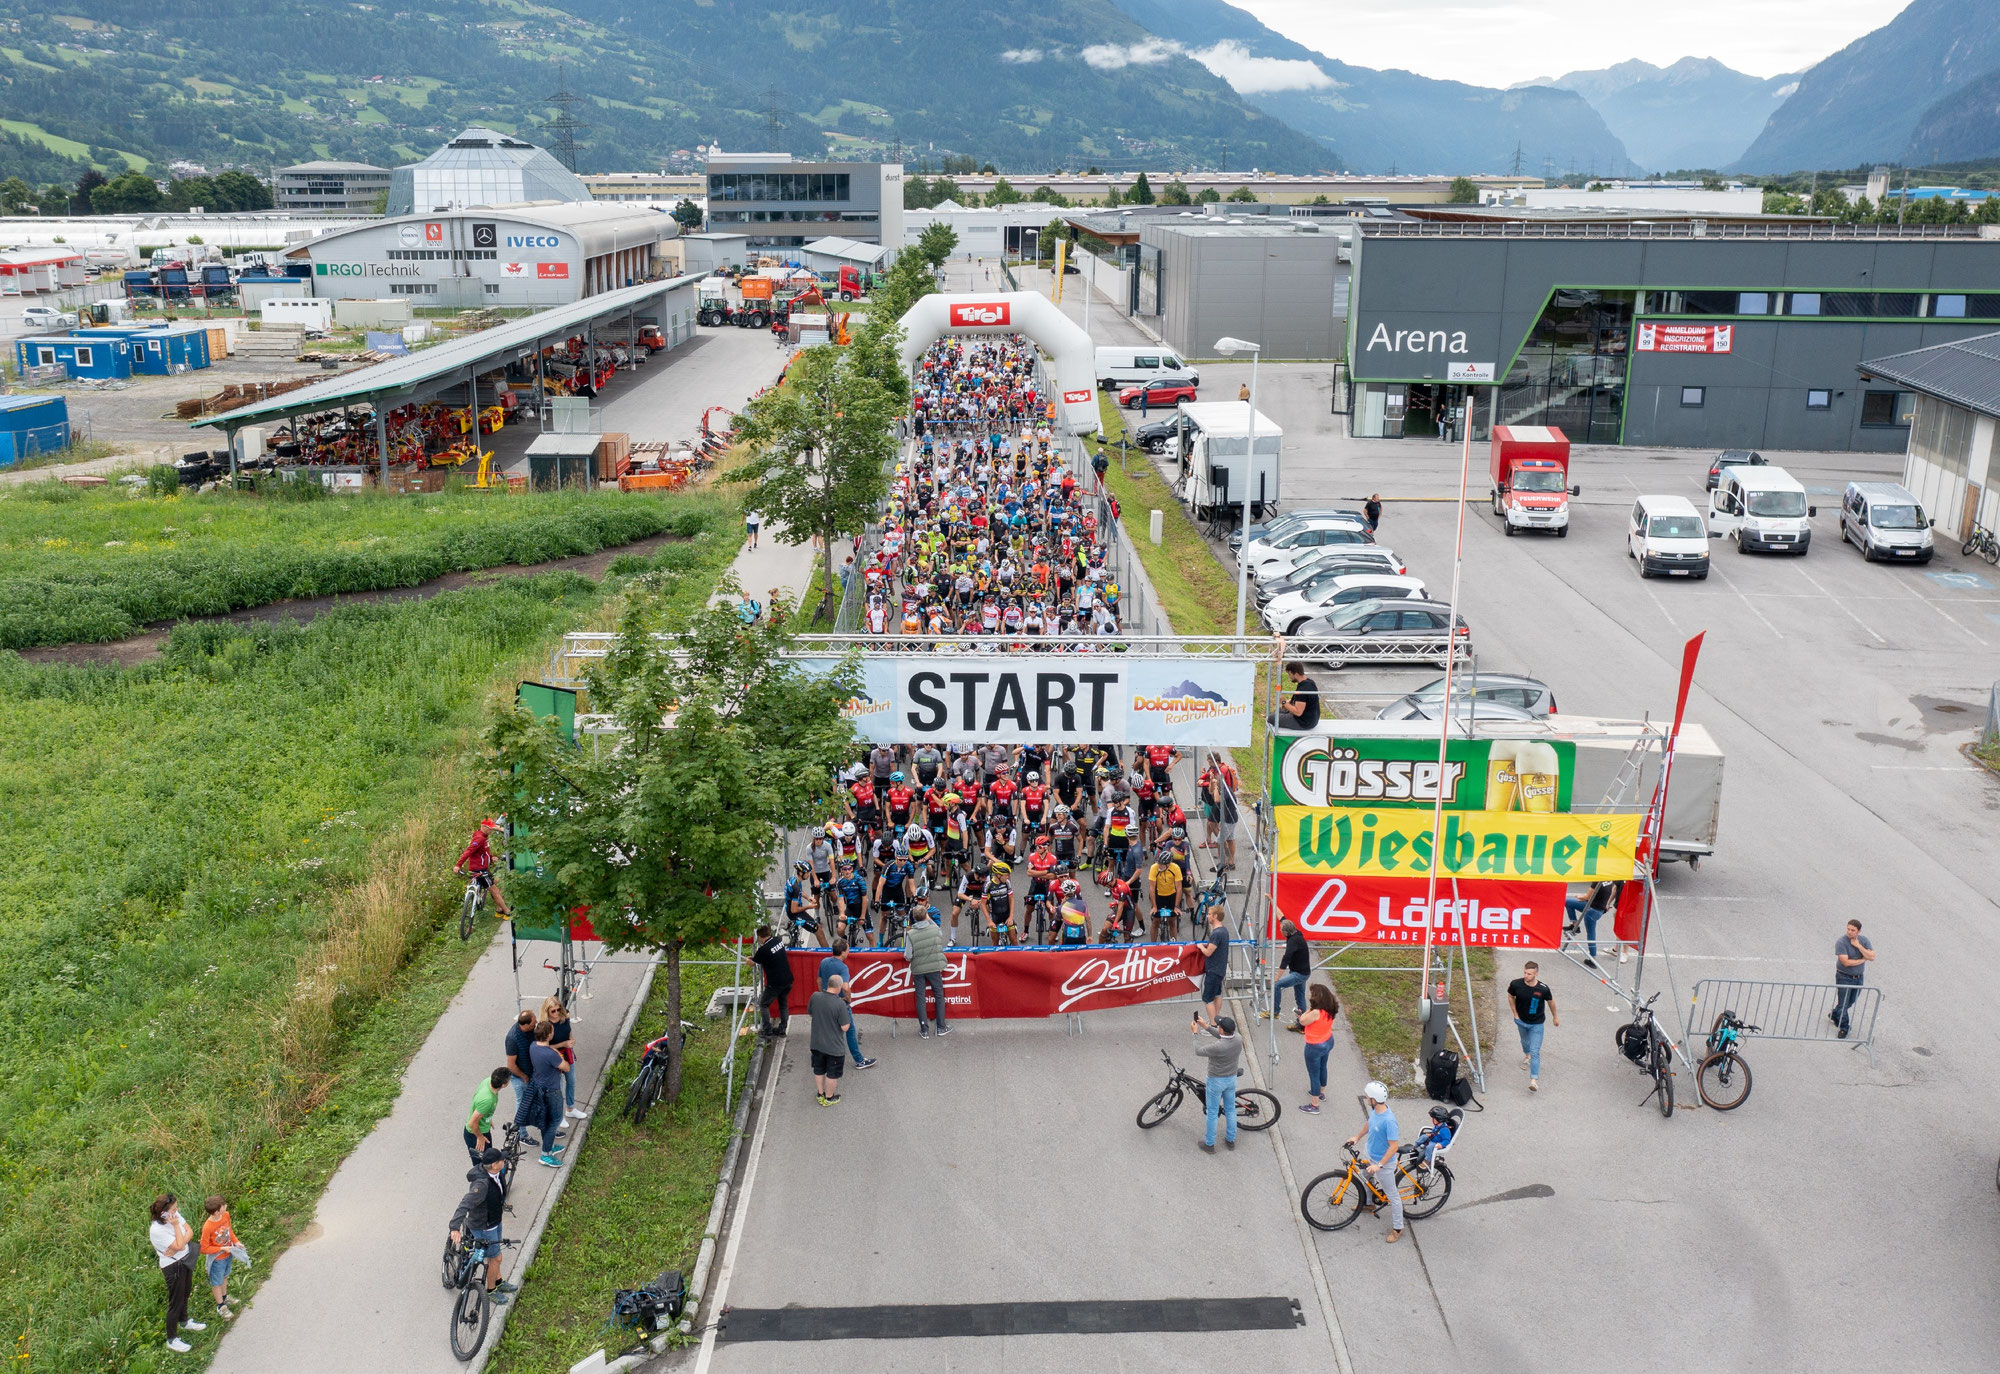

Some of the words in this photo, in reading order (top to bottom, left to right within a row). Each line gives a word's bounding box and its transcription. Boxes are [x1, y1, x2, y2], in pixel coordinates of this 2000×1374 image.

[507, 236, 559, 248] IVECO
[330, 263, 363, 276] RGO
[368, 263, 420, 276] Technik
[957, 305, 1003, 323] Tirol
[1366, 322, 1469, 354] Arena
[1665, 326, 1707, 334] ANMELDUNG
[1660, 343, 1708, 352] REGISTRATION
[1066, 391, 1089, 401] Tirol
[907, 671, 1119, 732] START
[1134, 696, 1215, 712] Dolomiten
[1165, 702, 1246, 725] Radrundfahrt
[1281, 736, 1465, 807] Gösser
[1299, 812, 1609, 876] Wiesbauer
[1378, 896, 1531, 930] Löffler
[1378, 930, 1418, 941] MADE
[1430, 932, 1459, 943] FOR
[1471, 933, 1530, 944] BETTER
[944, 995, 972, 1004] ergtirol
